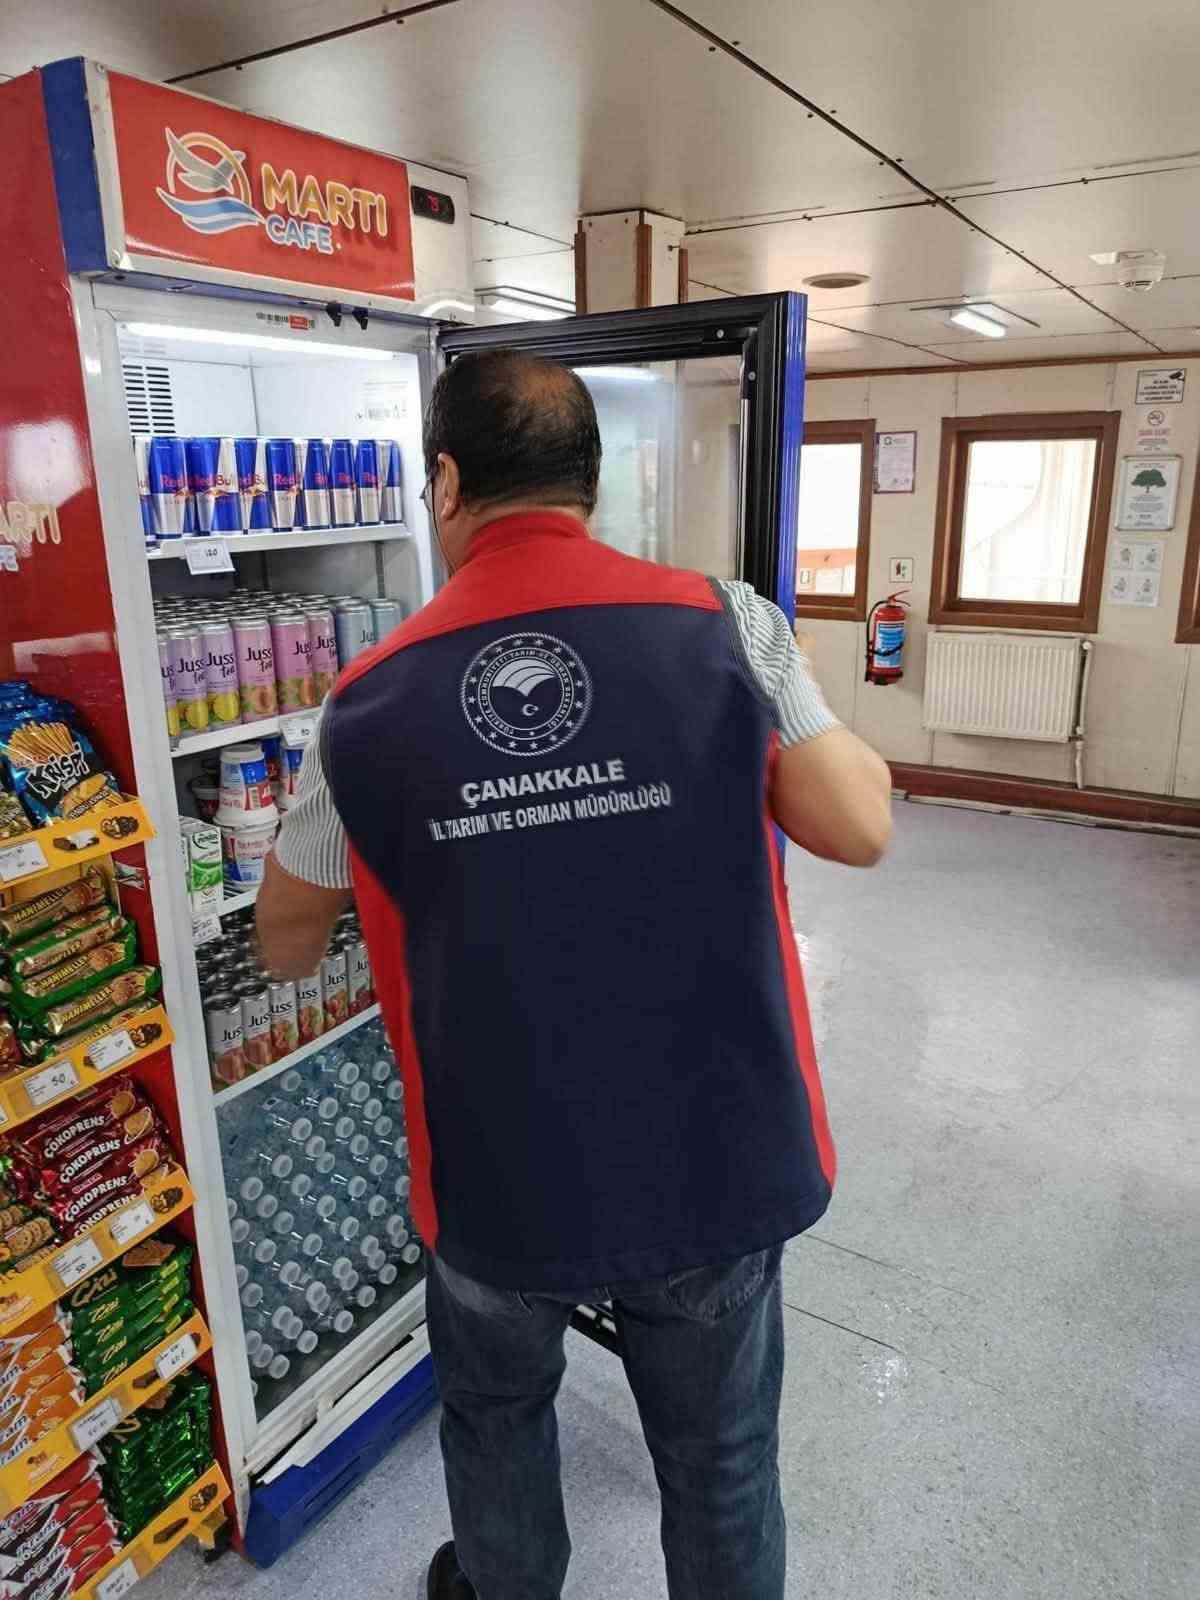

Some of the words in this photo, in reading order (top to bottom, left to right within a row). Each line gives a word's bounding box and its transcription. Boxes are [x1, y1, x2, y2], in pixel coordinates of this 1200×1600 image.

[261, 163, 387, 237] MARTI
[264, 214, 334, 255] CAFE
[360, 630, 375, 643] Ju
[206, 652, 235, 667] Juss
[246, 647, 272, 661] Juss
[460, 758, 625, 808] ÇANAKKALE
[491, 810, 514, 832] VE
[515, 801, 572, 828] ORMAN
[574, 781, 672, 819] MÜDÜRLÜĞÜ
[353, 959, 368, 973] Ju
[297, 987, 319, 1001] uss
